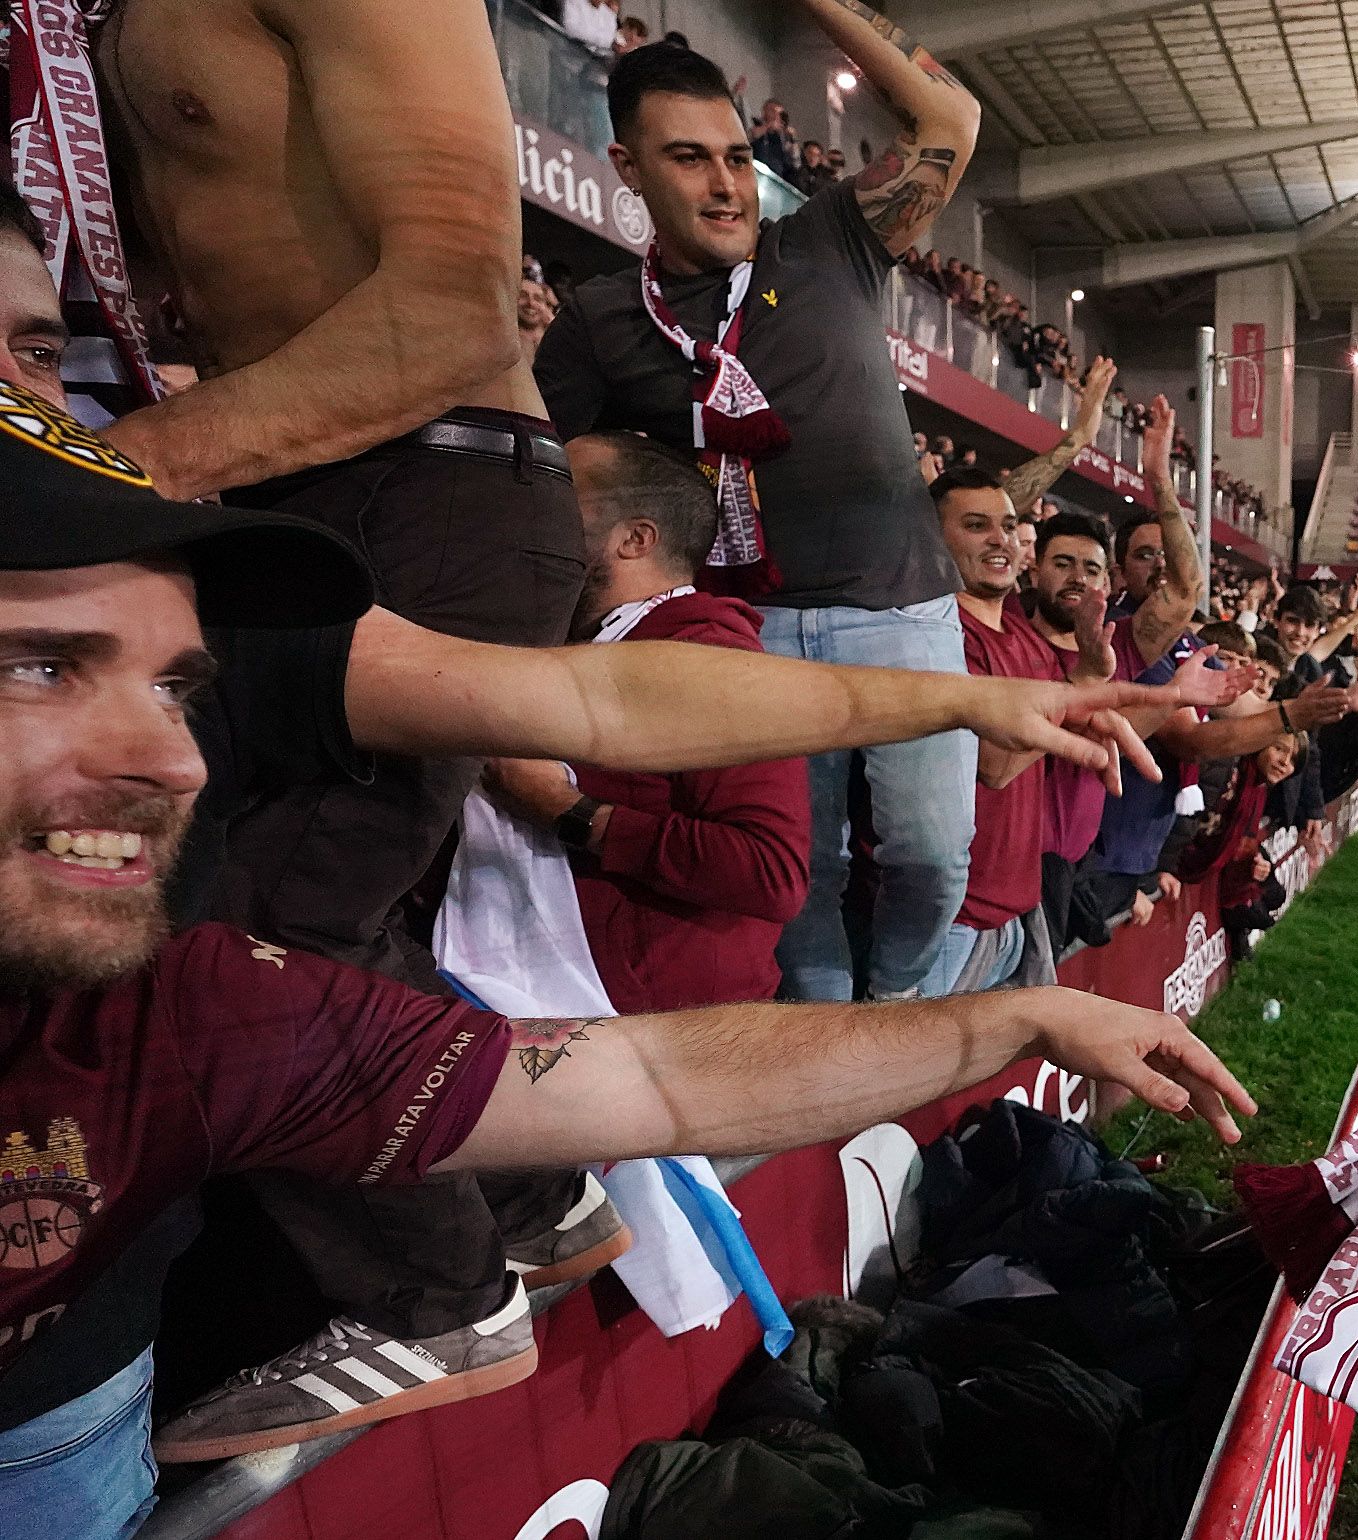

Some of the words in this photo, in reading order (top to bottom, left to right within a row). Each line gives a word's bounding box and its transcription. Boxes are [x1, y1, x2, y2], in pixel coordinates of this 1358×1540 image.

[37, 0, 80, 59] OS
[49, 65, 122, 279] GRANATES
[514, 124, 604, 225] licia
[367, 1138, 406, 1174] PARAR
[394, 1105, 426, 1138] ATA
[413, 1031, 476, 1100] VOLTAR
